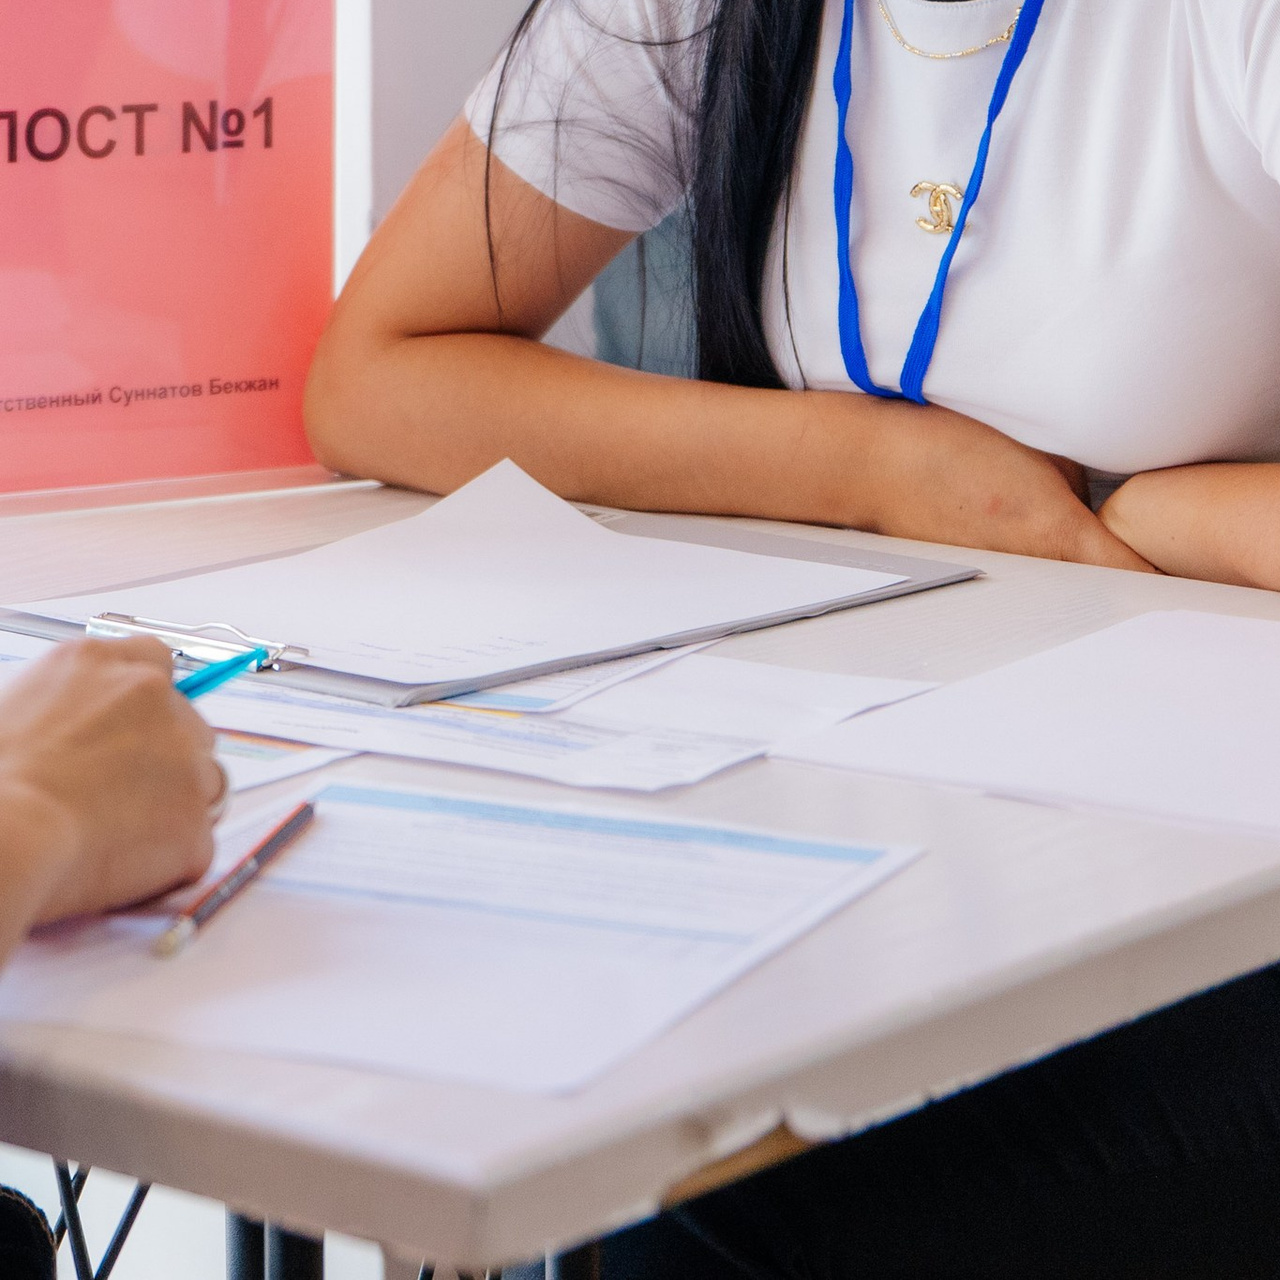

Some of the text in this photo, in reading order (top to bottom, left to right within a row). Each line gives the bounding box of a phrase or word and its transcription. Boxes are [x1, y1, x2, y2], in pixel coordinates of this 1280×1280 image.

[181, 97, 273, 154] №1
[109, 385, 203, 407] Суннатов
[209, 376, 280, 396] Бекжан
